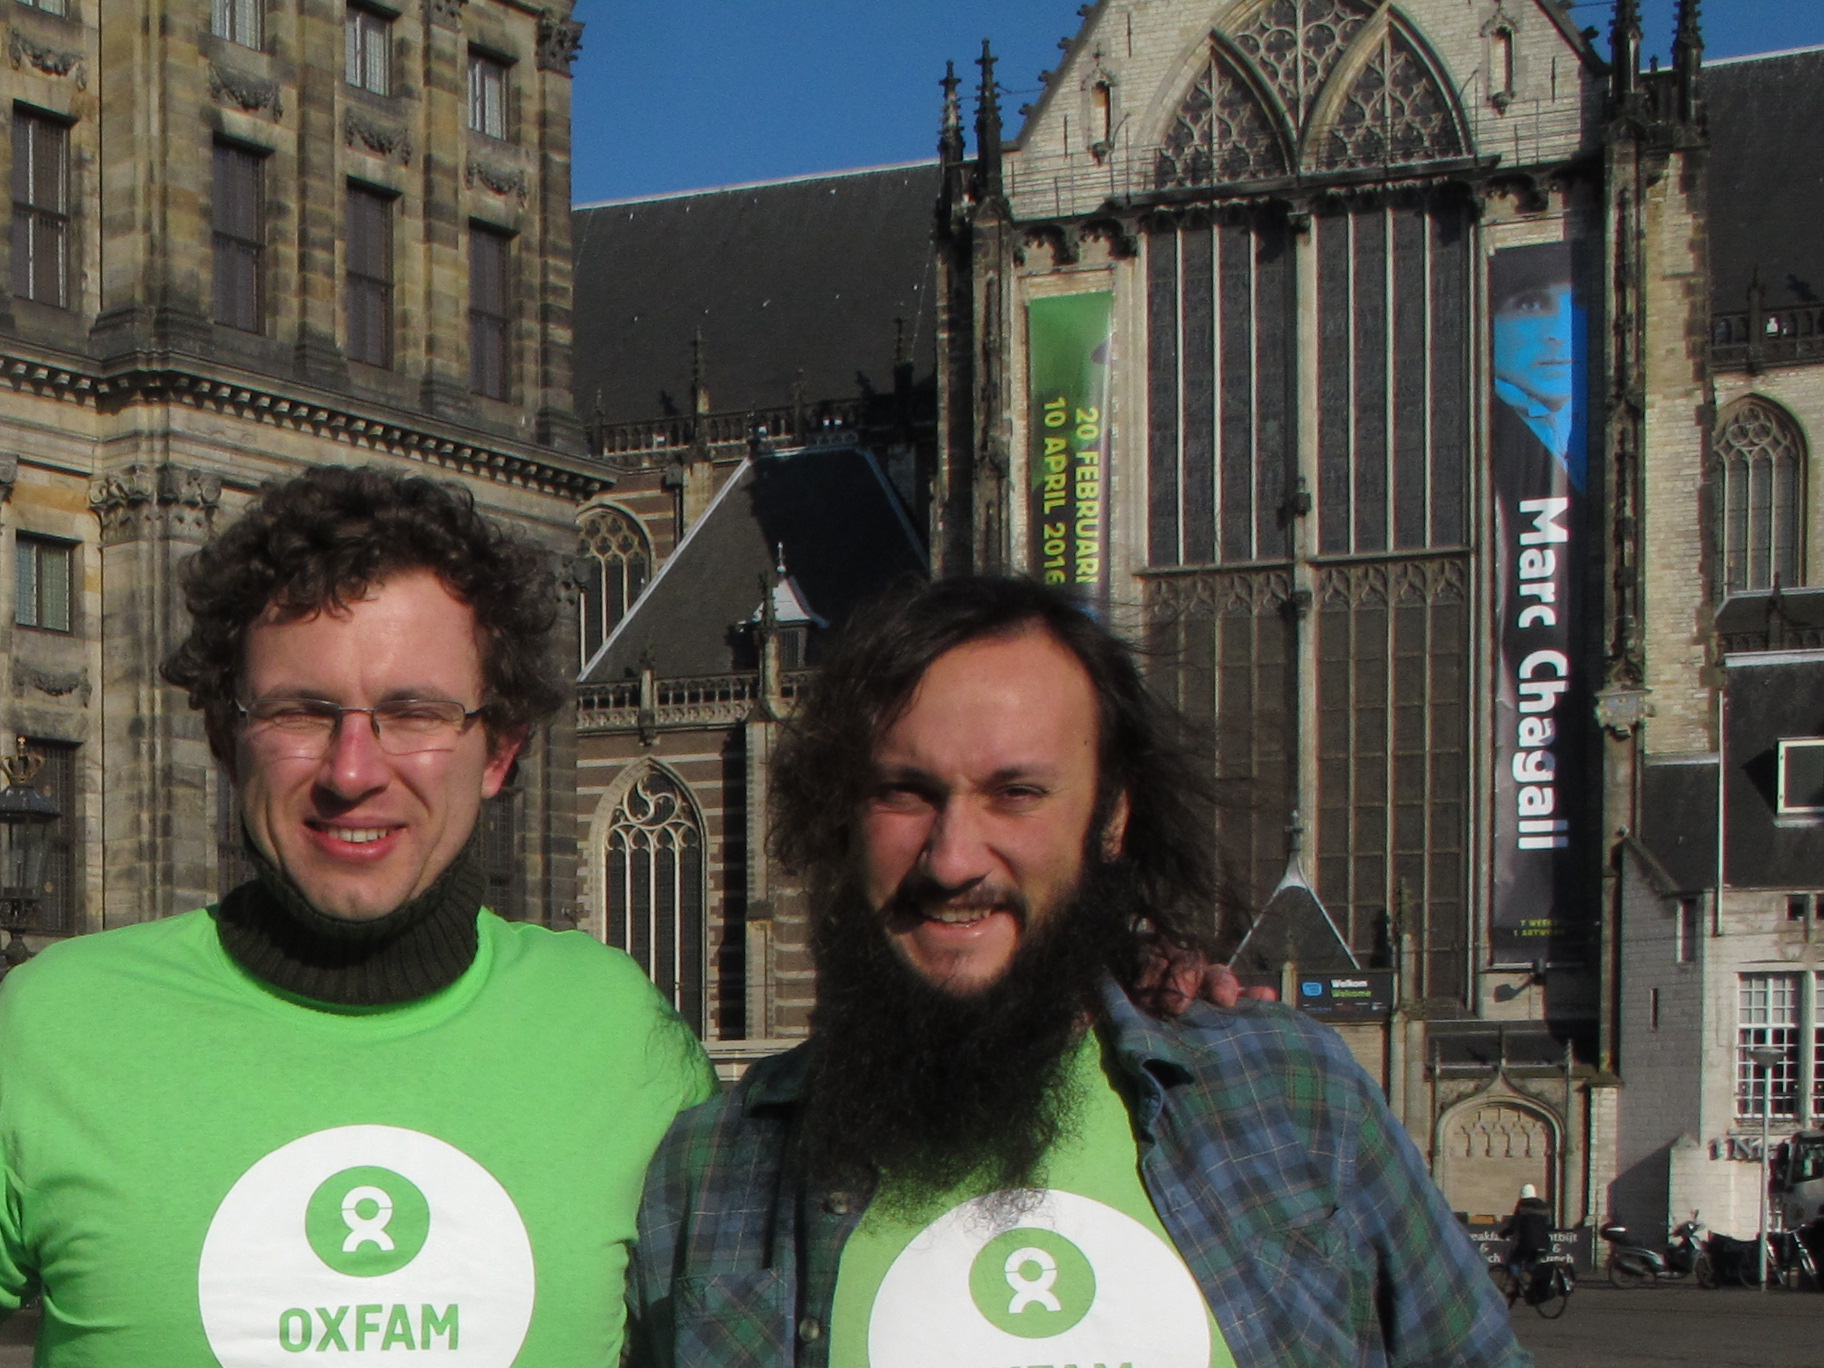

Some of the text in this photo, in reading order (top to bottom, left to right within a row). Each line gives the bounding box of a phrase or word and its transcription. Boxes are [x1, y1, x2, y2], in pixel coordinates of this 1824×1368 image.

[1043, 396, 1068, 586] 10 APRIL 2016
[1075, 406, 1100, 584] 20 FEBRUARI
[1512, 496, 1569, 850] Marc Chagall
[278, 1303, 460, 1353] OXFAM
